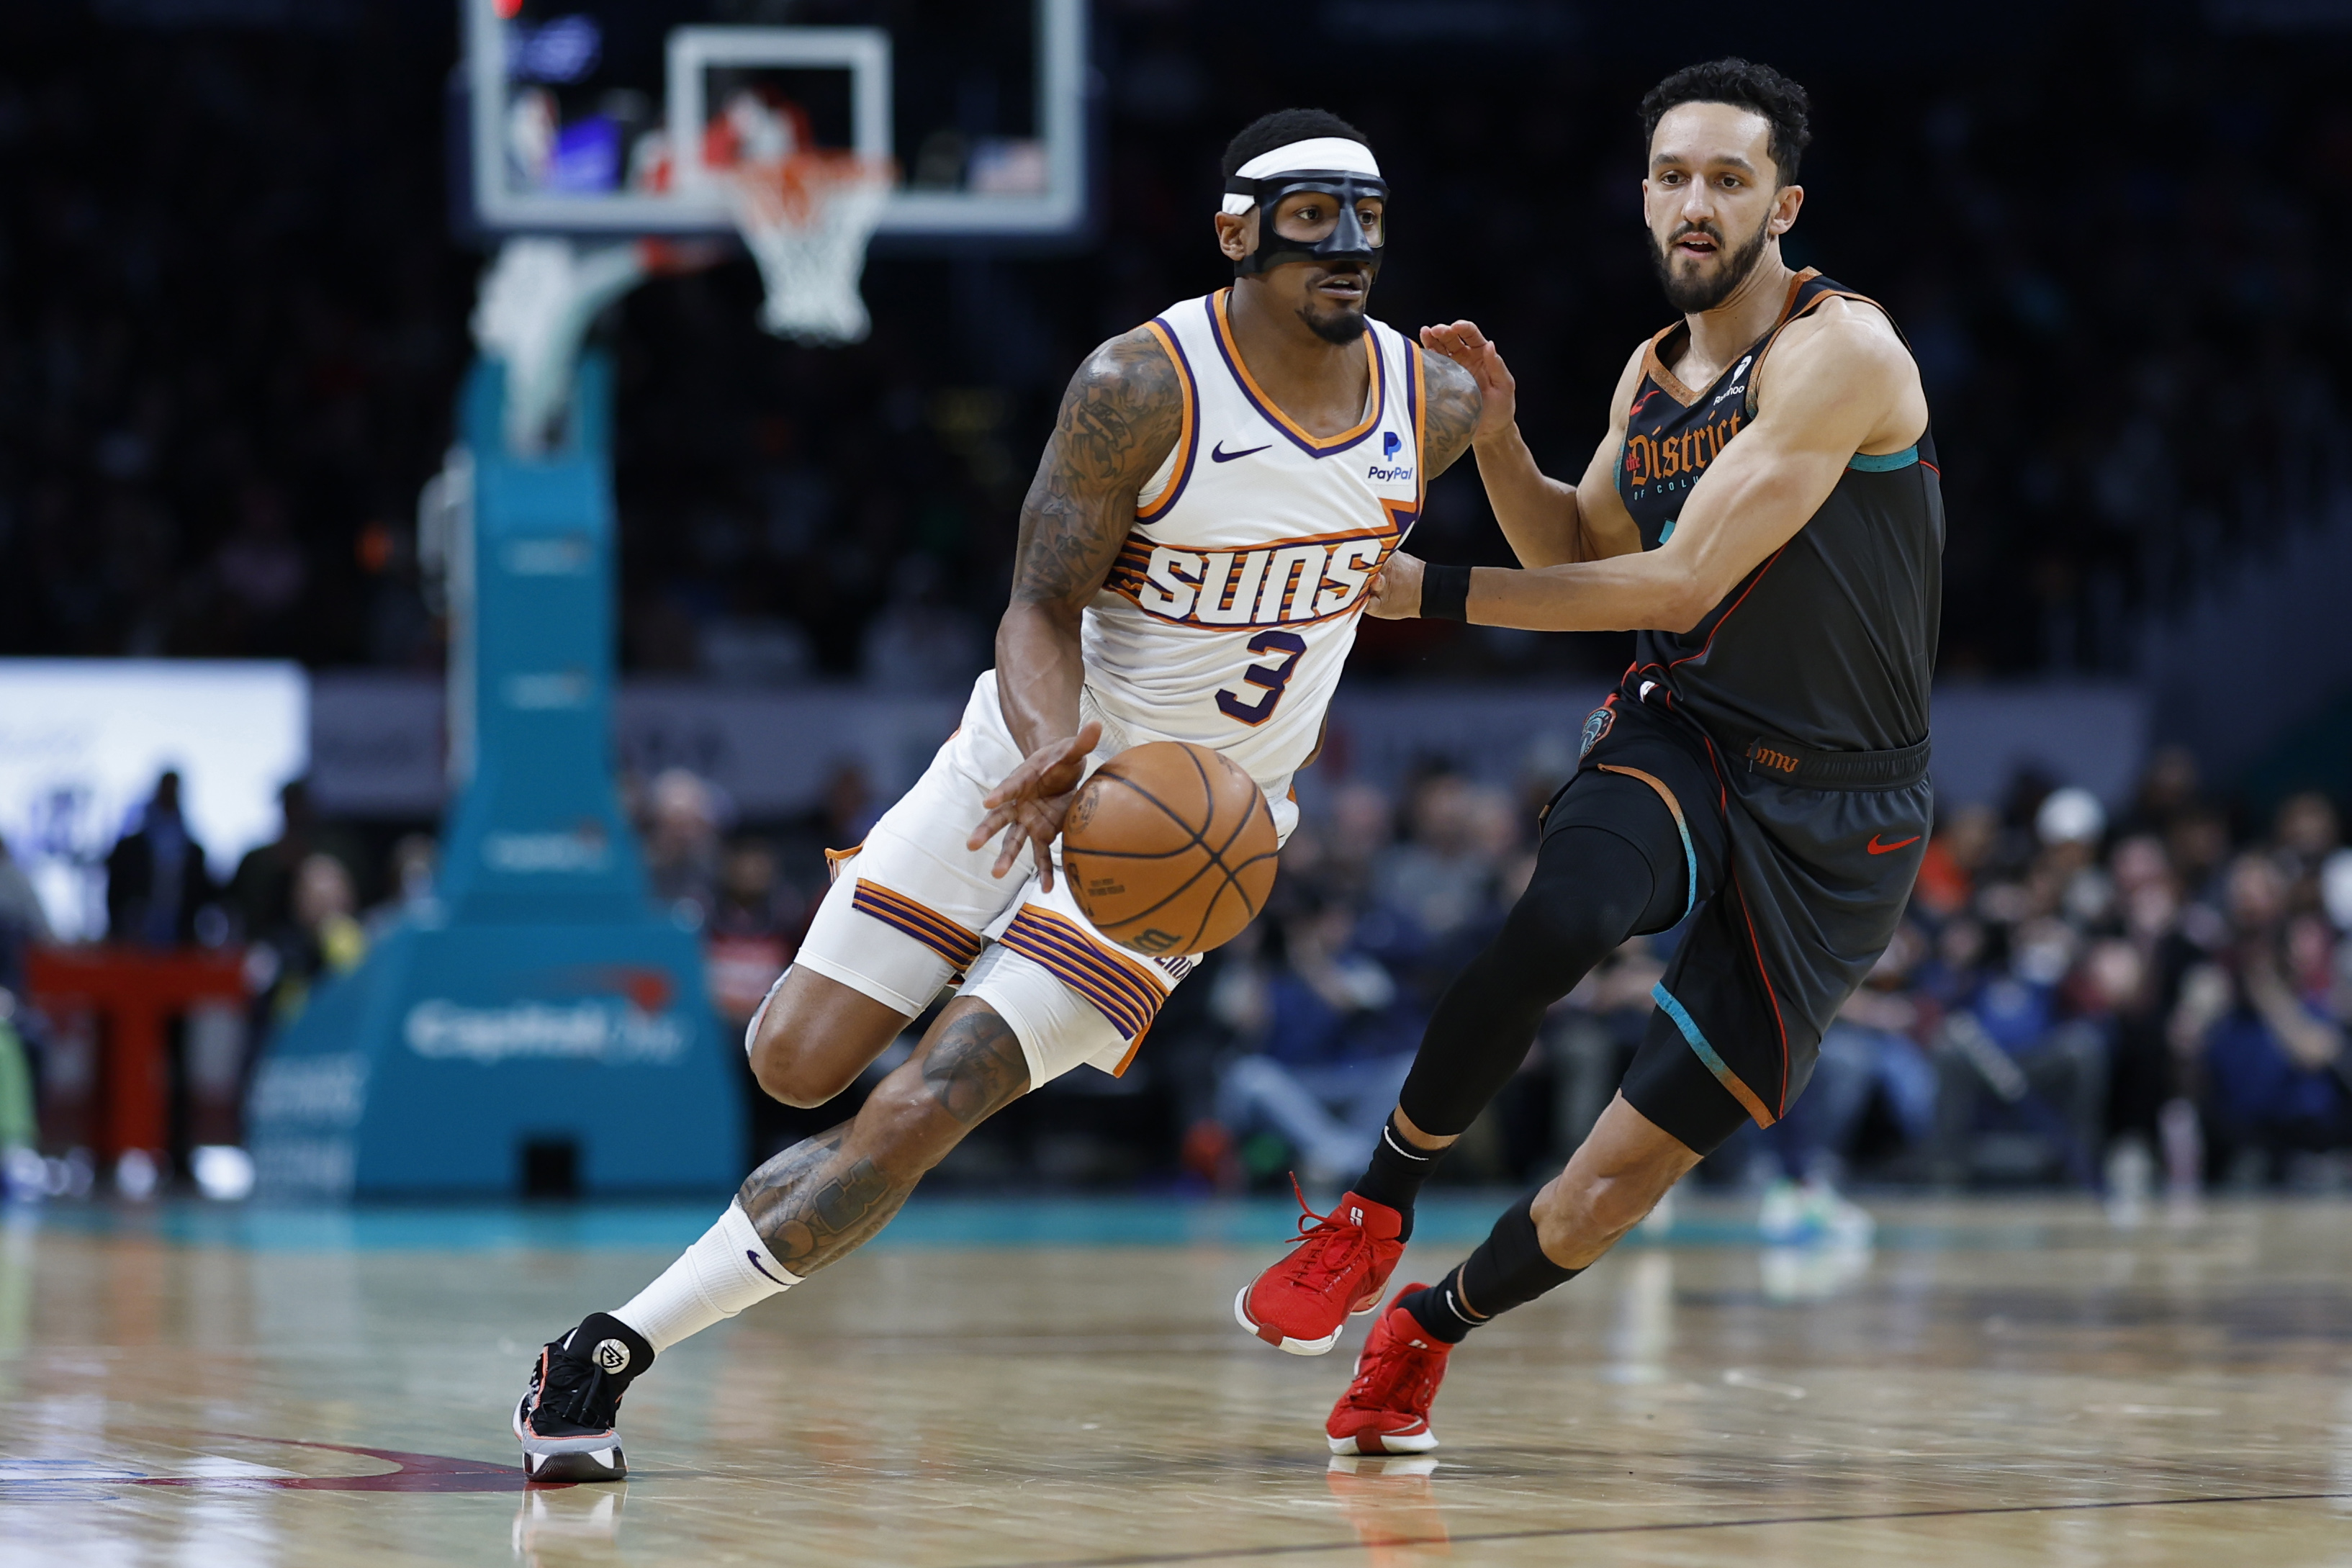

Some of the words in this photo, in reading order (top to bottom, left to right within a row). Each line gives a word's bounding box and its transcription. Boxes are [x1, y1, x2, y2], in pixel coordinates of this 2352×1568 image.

[1367, 466, 1413, 482] PayPal
[1628, 408, 1742, 487] District
[1634, 489, 1645, 501] OF
[1138, 537, 1384, 625] SUNS
[1215, 630, 1307, 728] 3
